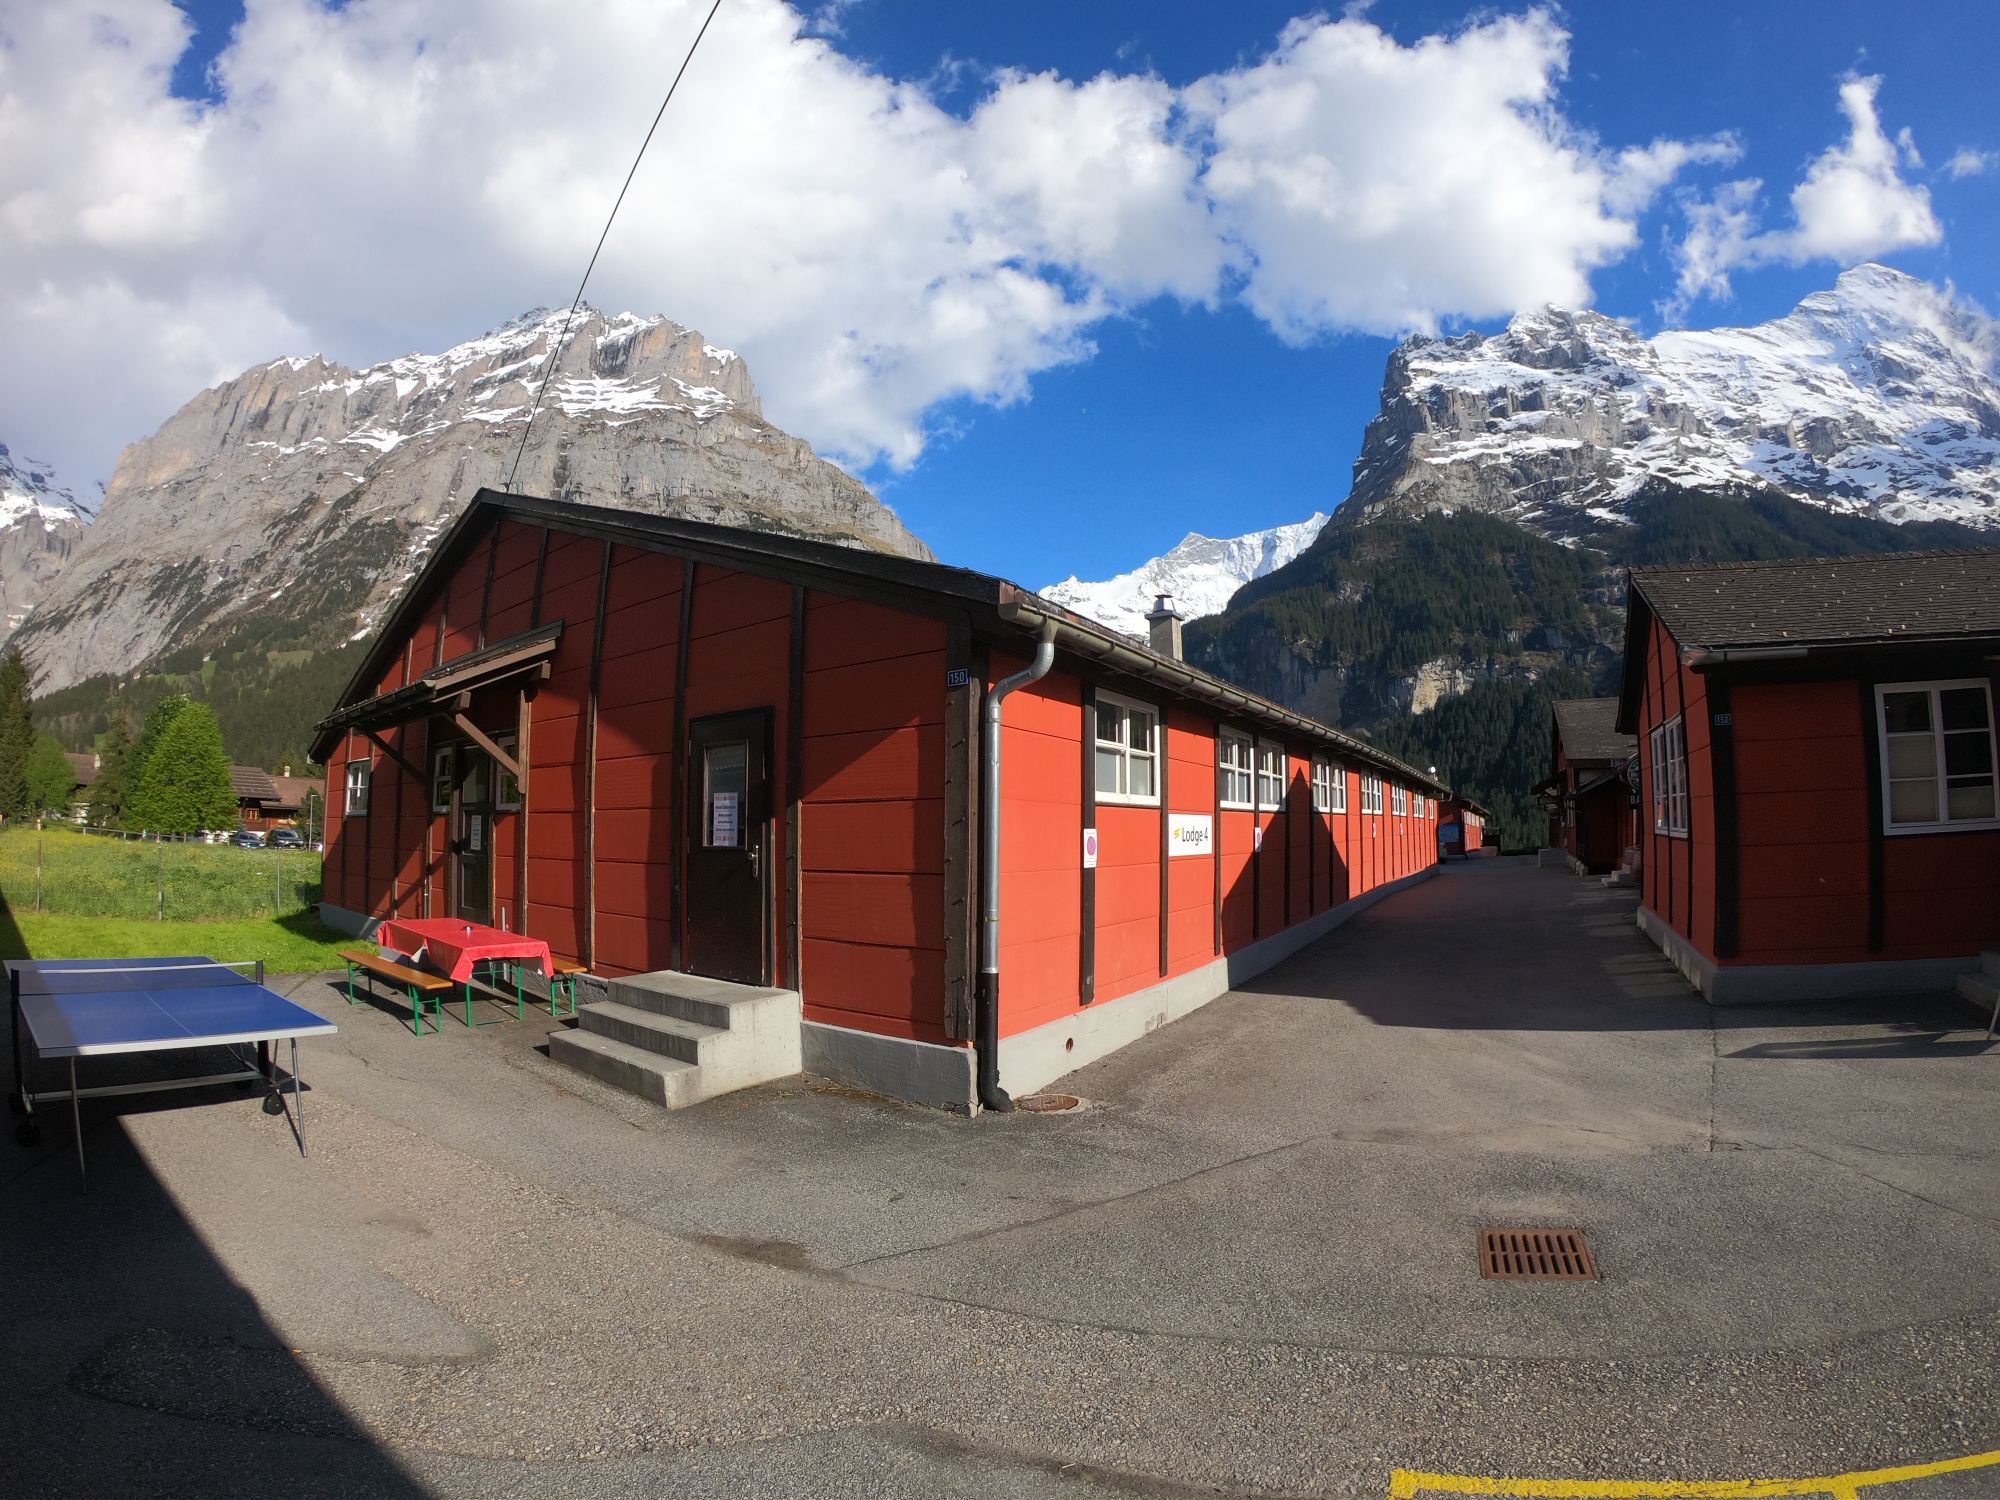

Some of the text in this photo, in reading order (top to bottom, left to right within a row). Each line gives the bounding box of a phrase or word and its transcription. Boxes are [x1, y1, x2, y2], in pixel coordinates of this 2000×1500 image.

[950, 671, 965, 684] 150
[1182, 825, 1208, 846] Lodge 4
